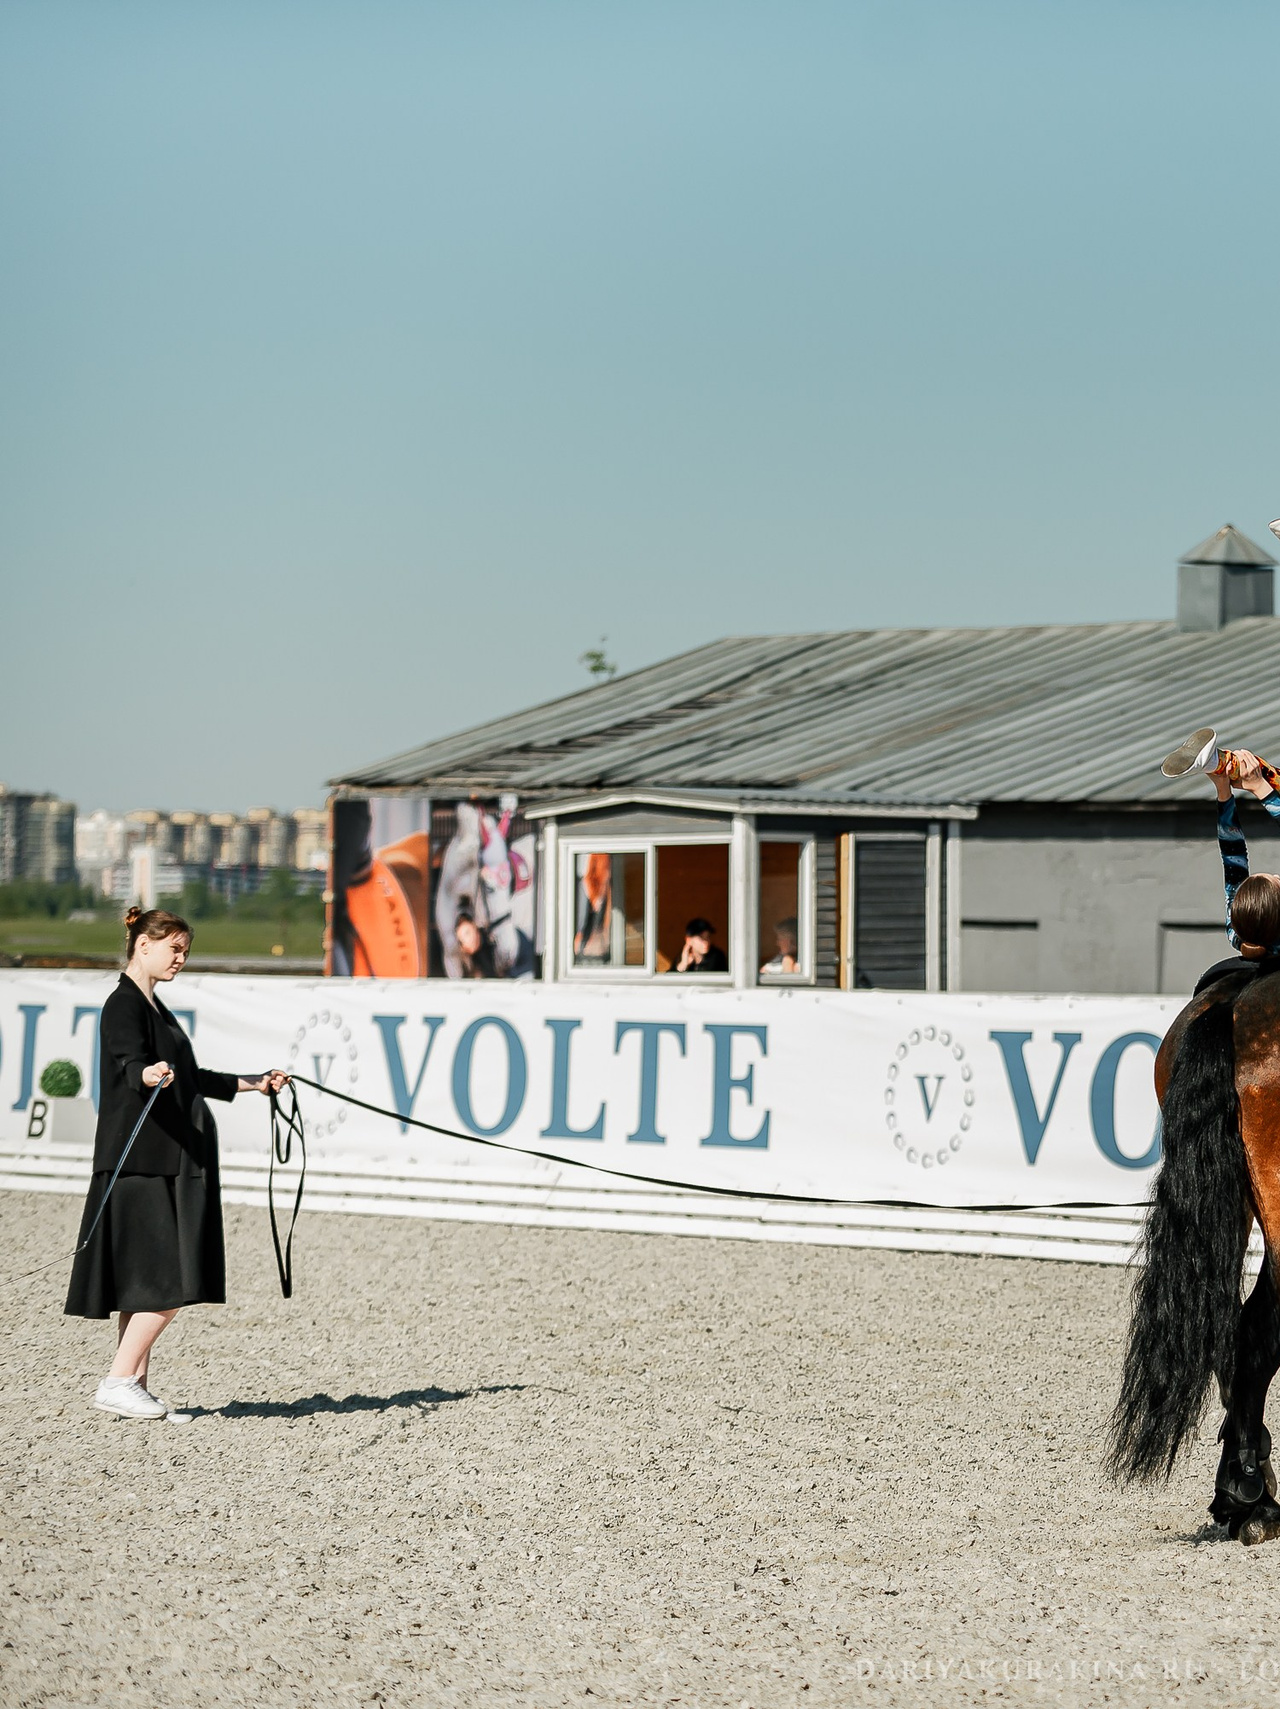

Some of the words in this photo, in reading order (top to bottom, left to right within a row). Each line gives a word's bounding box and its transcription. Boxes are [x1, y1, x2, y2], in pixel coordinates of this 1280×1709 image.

[371, 1014, 772, 1150] VOLTE
[914, 1074, 946, 1122] V
[27, 1100, 49, 1139] B
